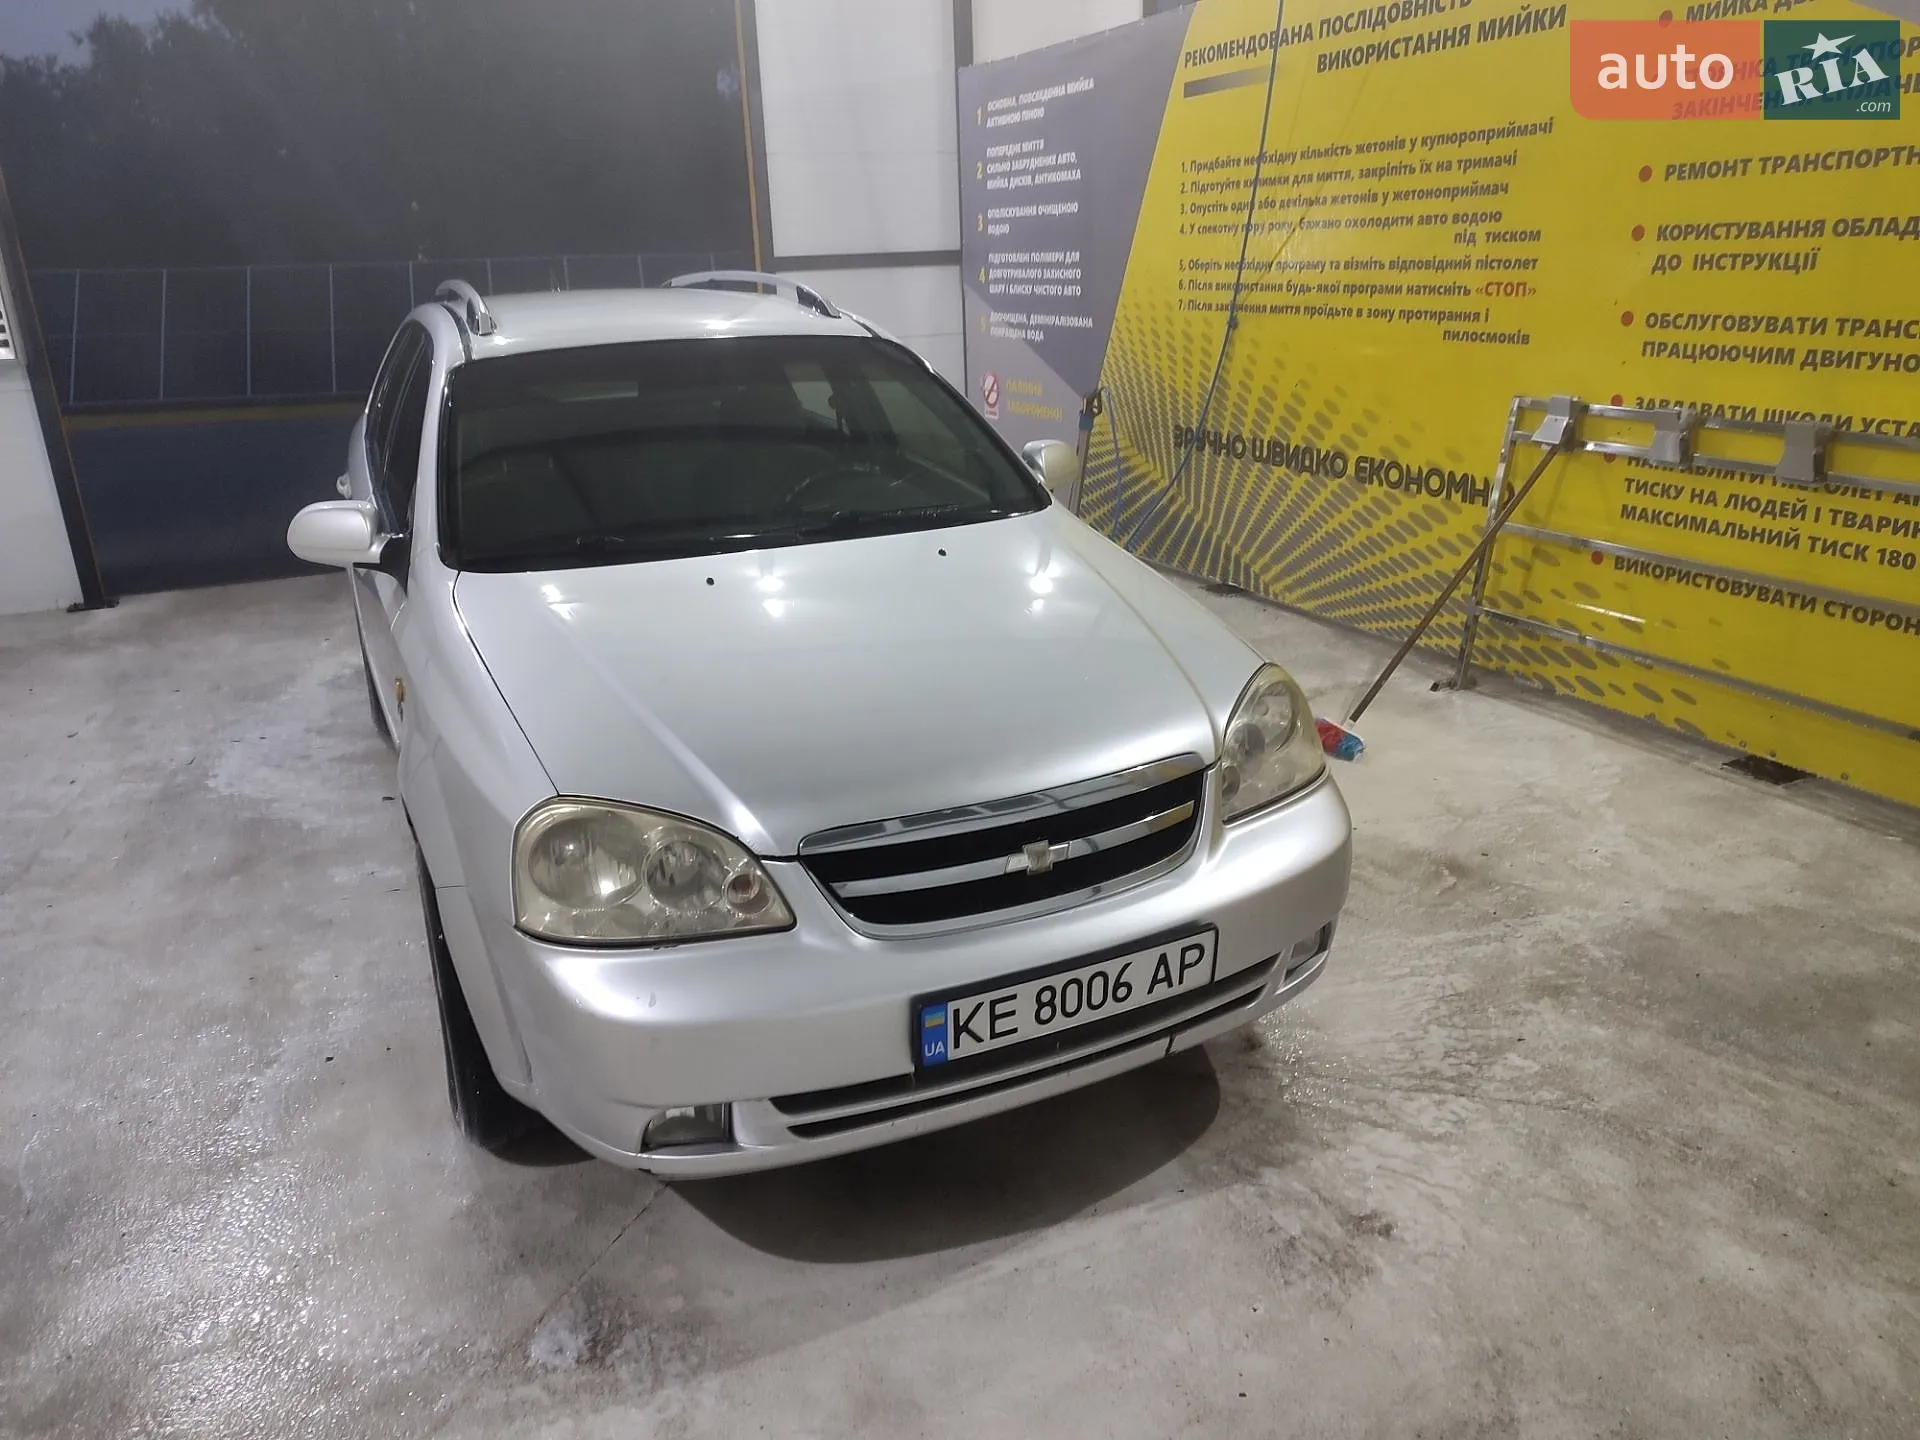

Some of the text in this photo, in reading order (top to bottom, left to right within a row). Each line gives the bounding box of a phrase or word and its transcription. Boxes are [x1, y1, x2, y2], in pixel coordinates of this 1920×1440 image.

[1184, 22, 1313, 68] РЕКОМЕНДОВАНА
[1317, 4, 1567, 73] ВИКОРИСТАННЯ МИЙКИ
[977, 106, 982, 125] 1
[1022, 107, 1044, 121] ПІНОЮ
[1181, 161, 1188, 173] 1.
[1190, 155, 1241, 175] Придбайте
[1300, 143, 1352, 161] кількість
[1355, 135, 1406, 154] жетонів
[1409, 137, 1417, 152] у
[1421, 116, 1554, 150] купюроприймачі
[1058, 152, 1077, 165] АВТО,
[1664, 157, 1753, 182] РЕМОНТ
[977, 161, 982, 179] 2
[1180, 182, 1188, 194] 2.
[1190, 178, 1241, 195] Підготуйте
[1292, 173, 1313, 187] для
[1316, 168, 1354, 184] миття,
[1358, 158, 1416, 181] закріпіть
[1420, 159, 1432, 174] їх
[1436, 160, 1453, 172] на
[1456, 149, 1518, 174] тримачі
[1038, 202, 1078, 217] ОЧИЩЕНОЮ
[1180, 203, 1188, 215] 3.
[1190, 200, 1229, 217] Опустіть
[1258, 195, 1277, 210] або
[1279, 194, 1327, 211] декілька
[1330, 188, 1378, 206] жетонів
[1382, 190, 1390, 207] у
[1392, 180, 1509, 203] жетоноприймач
[977, 213, 983, 231] 3
[988, 223, 1009, 235] ВОДОЮ
[1179, 223, 1188, 235] 4.
[1189, 222, 1195, 235] У
[1197, 222, 1240, 238] спекотну
[1344, 214, 1414, 231] охолодити
[1417, 212, 1448, 226] авто
[1452, 210, 1503, 227] водою
[1656, 215, 1920, 242] КОРИСТУВАННЯ ОБЛАД
[1454, 228, 1542, 246] під тиском
[1065, 251, 1080, 264] ДЛЯ
[1188, 259, 1222, 273] Оберіть
[1276, 258, 1326, 274] програму
[1330, 260, 1340, 271] та
[1343, 256, 1385, 271] візміть
[1388, 255, 1472, 273] відповідний
[1475, 255, 1539, 271] пістолет
[1651, 248, 1822, 275] ДО ІНСТРУКЦІЇ
[979, 266, 985, 284] 4
[1043, 268, 1081, 280] ЗАХИСНОГО
[1034, 285, 1062, 296] ЧИСТОГО
[1063, 285, 1081, 297] АВТО
[1178, 280, 1187, 291] 6.
[1188, 279, 1213, 291] Після
[1286, 280, 1341, 297] будь-якої
[1343, 283, 1403, 299] програми
[1406, 282, 1471, 297] натисніть
[1475, 281, 1537, 297] «СТОП»
[1178, 300, 1186, 311] 7.
[1188, 300, 1212, 312] Після
[1269, 304, 1300, 315] миття
[1303, 303, 1353, 319] проїдьте
[1356, 307, 1363, 317] в
[1367, 306, 1395, 323] зону
[1398, 308, 1480, 325] протирання
[1484, 308, 1489, 322] і
[1645, 311, 1828, 337] ОБСЛУГОВУВАТИ
[1027, 329, 1044, 342] ВОДА
[1443, 328, 1530, 346] пилосмоків
[1642, 340, 1920, 373] ПРАЦЮЮЧИМ ДВИГУНО
[1252, 438, 1349, 479] ШВИДКО
[1624, 478, 1684, 501] ТИСКУ
[1690, 488, 1718, 507] НА
[1723, 492, 1808, 522] ЛЮДЕЙ
[1813, 506, 1821, 523] І
[1620, 503, 1917, 570] МАКСИМАЛЬНИЙ ТИСК 180
[1614, 555, 1920, 636] ВИКОРИСТОВУВАТИ СТОРОН
[953, 943, 1205, 1049] KE 8006 AP
[924, 1041, 945, 1058] UA
